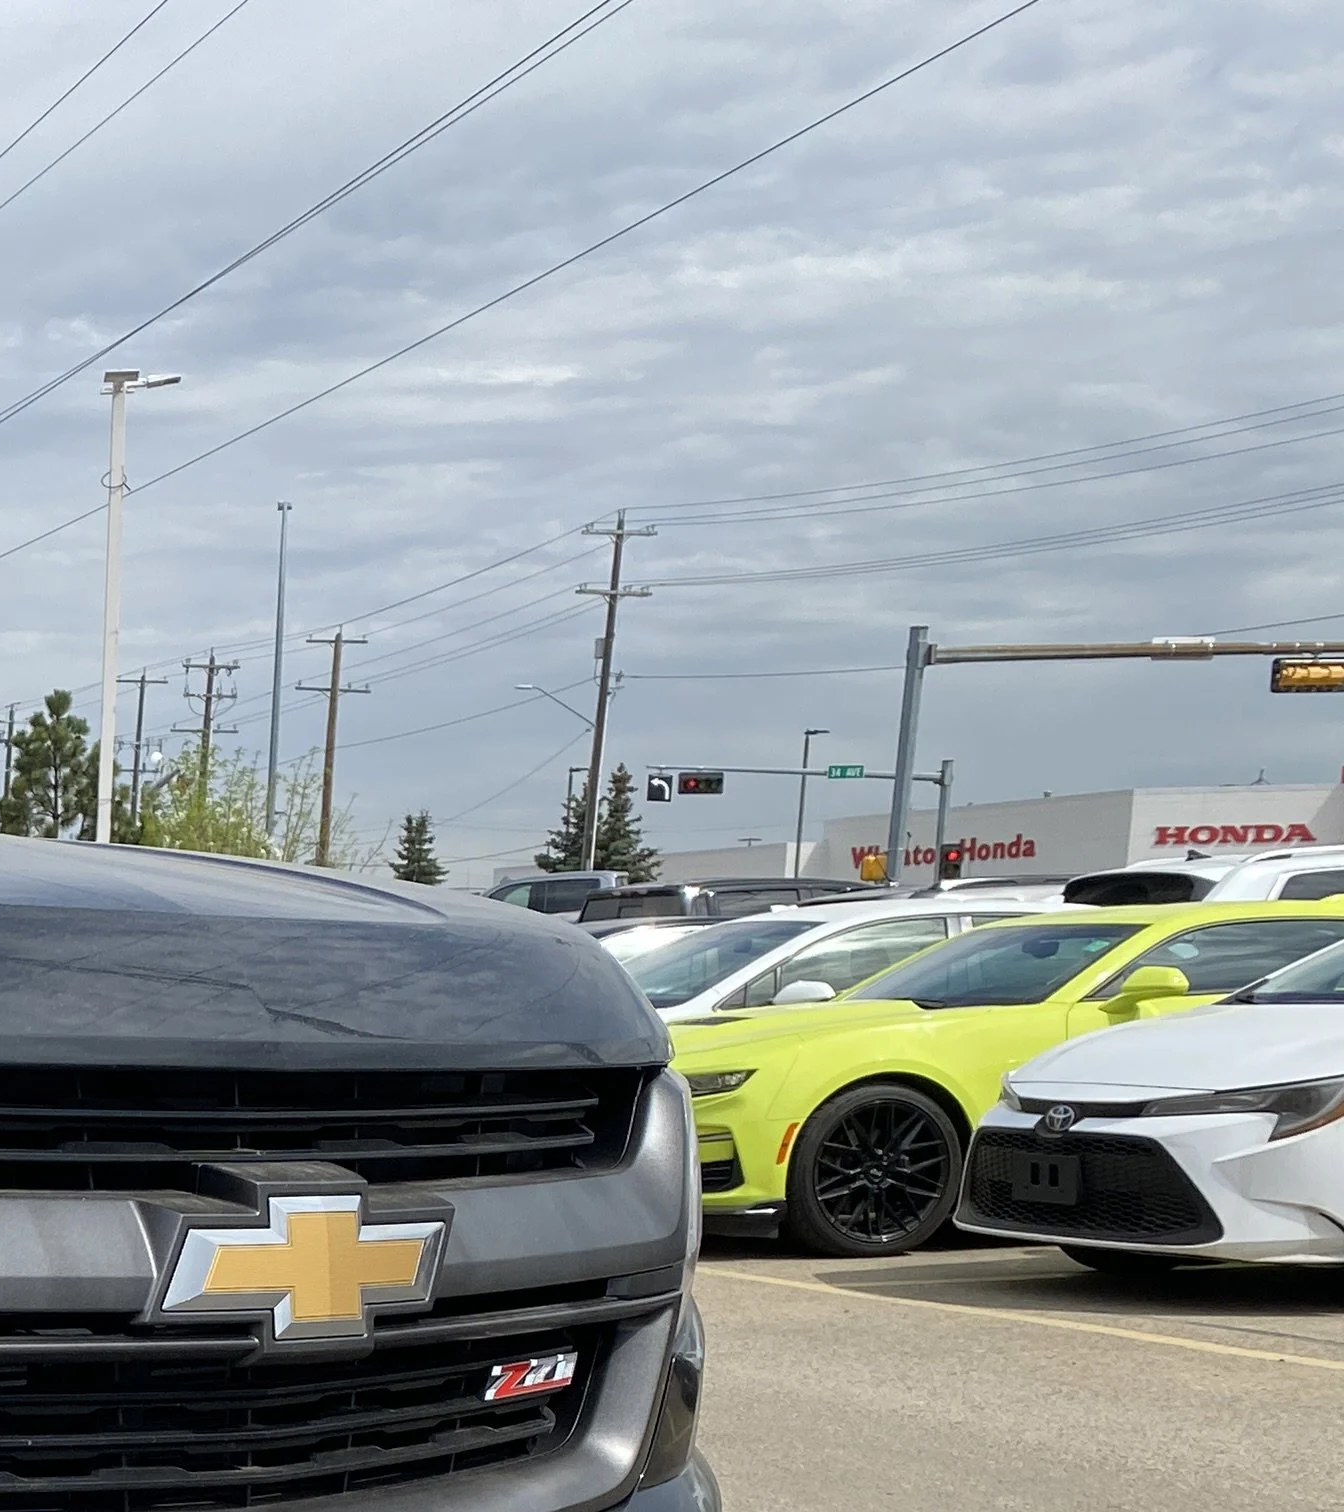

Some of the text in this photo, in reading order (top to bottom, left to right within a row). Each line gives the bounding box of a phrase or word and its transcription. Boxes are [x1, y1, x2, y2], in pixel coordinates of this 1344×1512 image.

[846, 767, 861, 777] AVE
[1154, 823, 1317, 846] HONDA
[960, 834, 1036, 862] Honda
[484, 1351, 578, 1401] Z71
